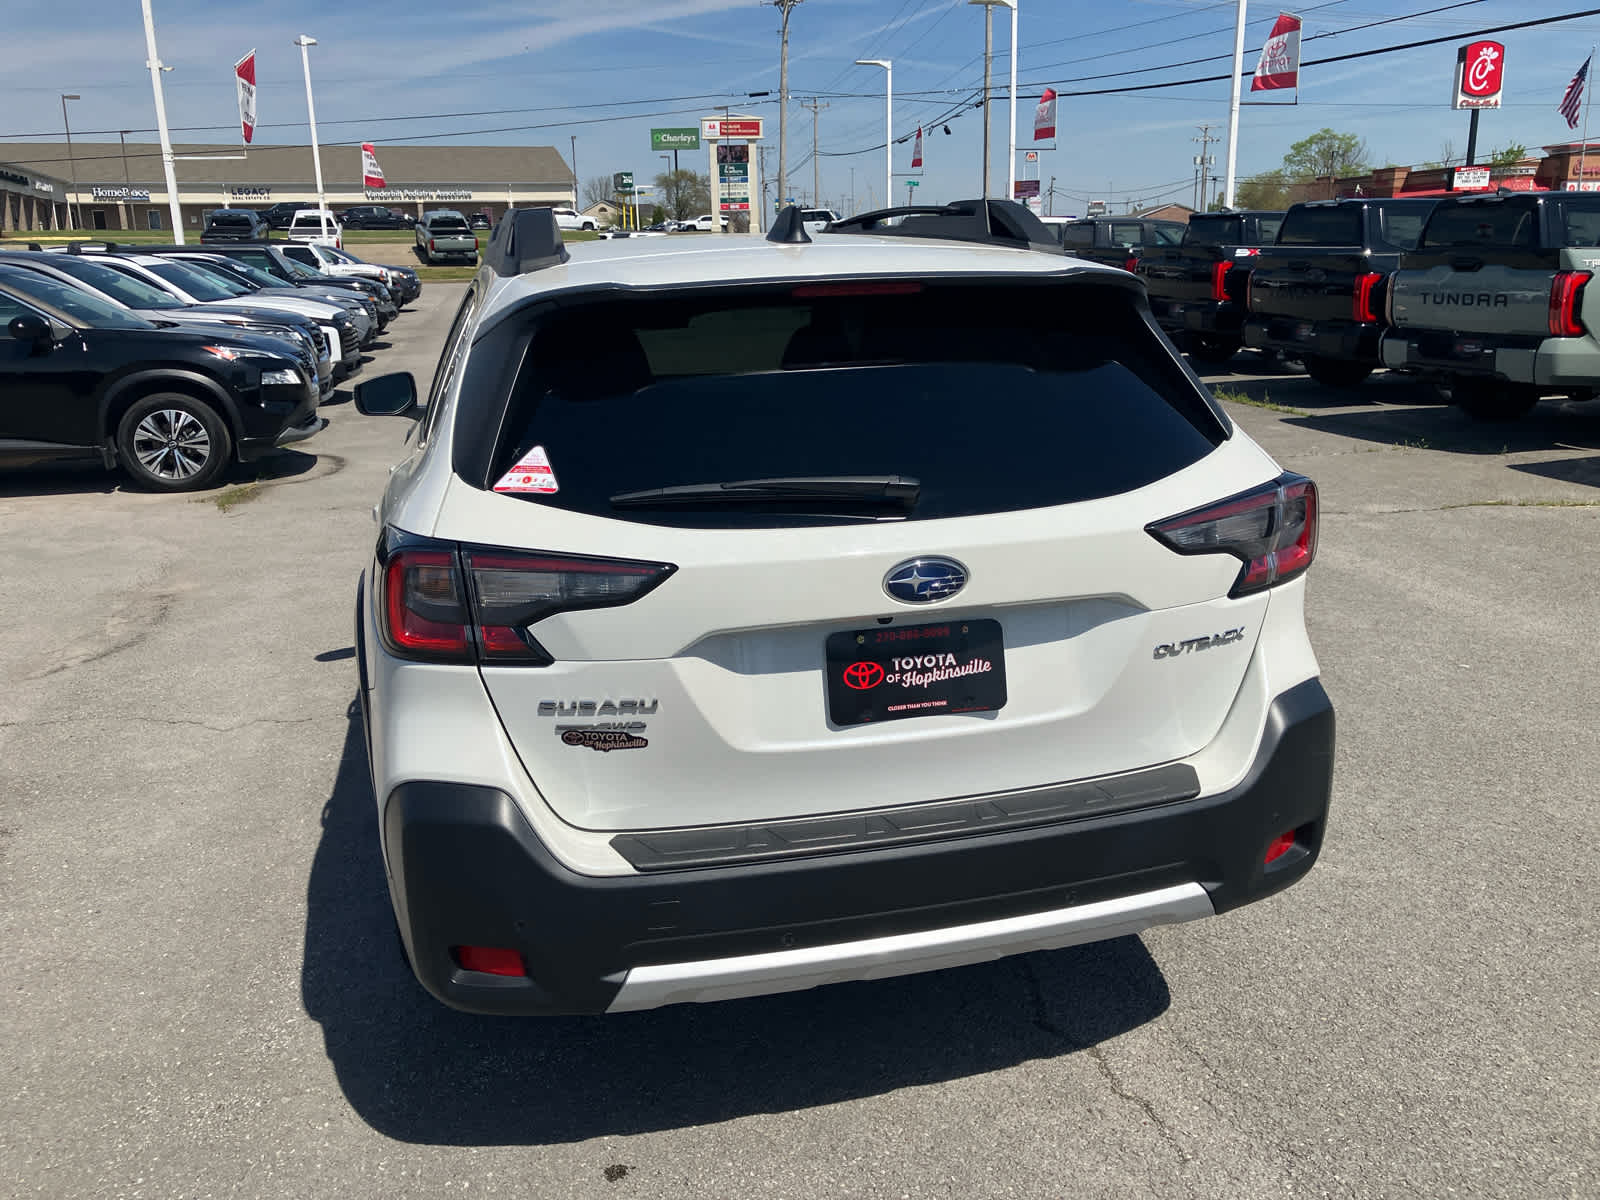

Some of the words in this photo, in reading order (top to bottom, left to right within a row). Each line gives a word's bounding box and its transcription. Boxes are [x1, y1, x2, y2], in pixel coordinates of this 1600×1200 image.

[231, 187, 271, 195] LEGACY
[404, 189, 433, 197] Pediatric
[436, 189, 473, 197] Associates
[1421, 292, 1508, 307] TUNDRA
[1153, 626, 1245, 660] OUTBACK
[892, 652, 957, 671] TOYOTA
[886, 673, 902, 683] OF
[901, 658, 992, 689] Hopkinsville
[537, 699, 658, 716] SUBARU
[584, 732, 628, 741] TOYOTA
[594, 739, 647, 750] Hopkinsville
